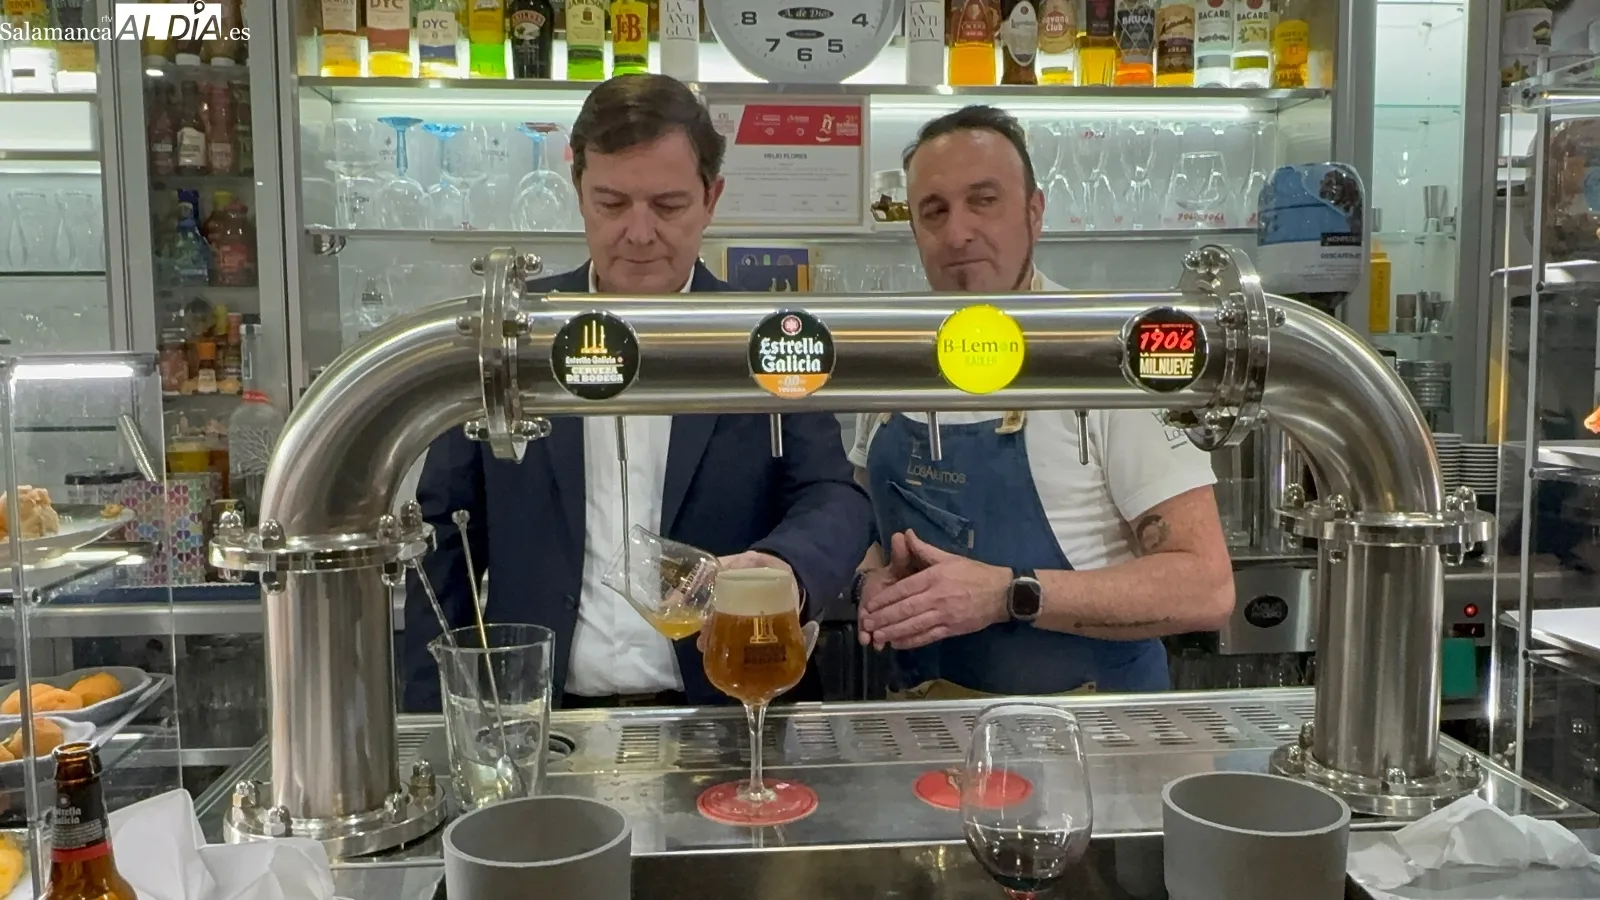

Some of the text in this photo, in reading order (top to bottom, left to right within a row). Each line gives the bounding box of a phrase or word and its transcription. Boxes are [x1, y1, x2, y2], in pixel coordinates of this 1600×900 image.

[422, 19, 448, 29] DYC
[741, 11, 757, 25] 8
[851, 13, 869, 27] 4
[613, 13, 642, 42] J&B
[1046, 23, 1063, 31] Club
[765, 38, 780, 52] 7
[828, 39, 843, 53] 5
[797, 48, 813, 62] 6
[760, 337, 824, 355] Estrella
[1140, 330, 1194, 352] 1906
[761, 354, 821, 373] Galicia
[1140, 358, 1194, 375] MILNUEVE
